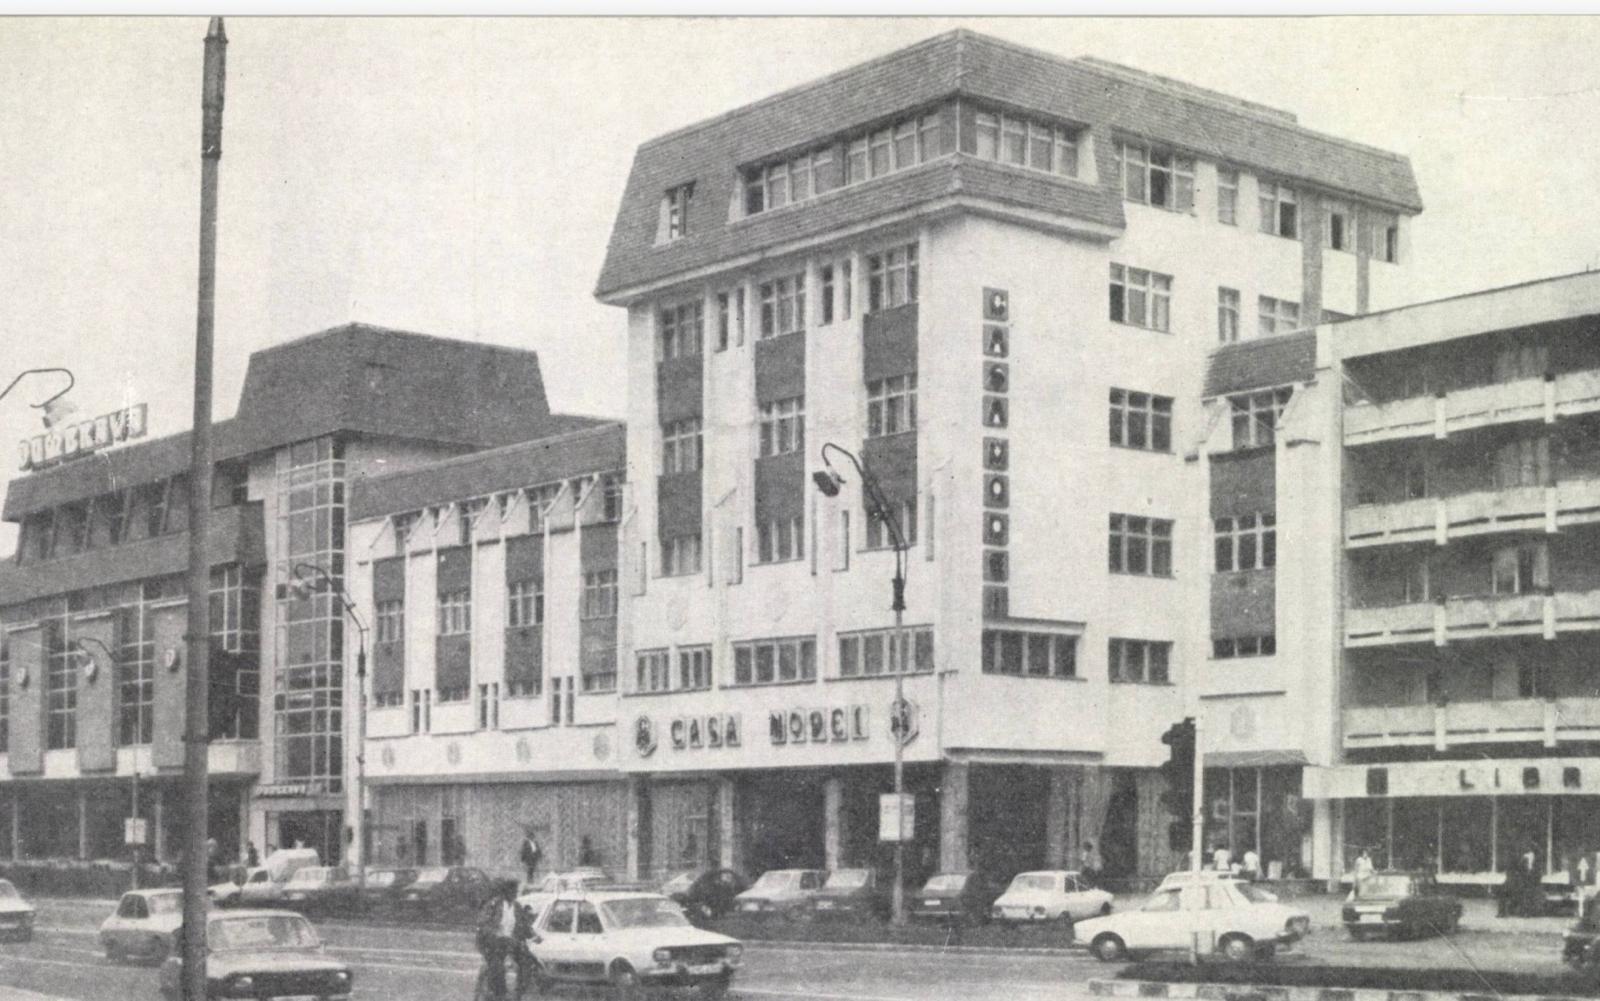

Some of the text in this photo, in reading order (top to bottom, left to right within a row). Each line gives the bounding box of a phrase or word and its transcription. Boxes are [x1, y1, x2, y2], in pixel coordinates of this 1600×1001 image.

[670, 715, 740, 747] CASA
[769, 705, 867, 744] MODEI
[1459, 766, 1582, 789] LIBR
